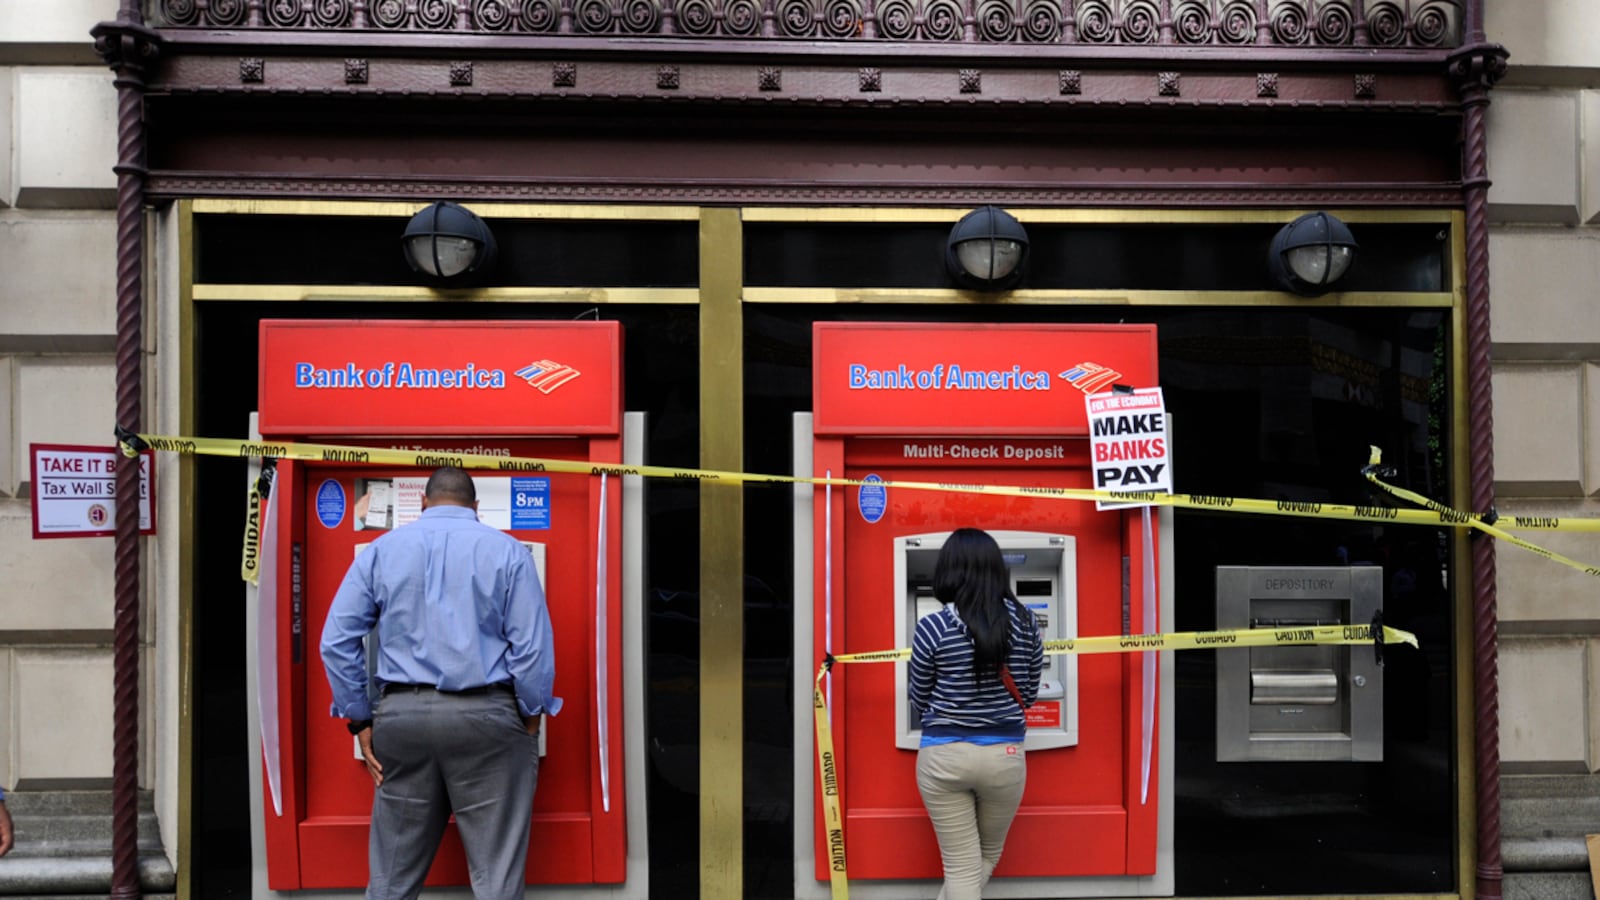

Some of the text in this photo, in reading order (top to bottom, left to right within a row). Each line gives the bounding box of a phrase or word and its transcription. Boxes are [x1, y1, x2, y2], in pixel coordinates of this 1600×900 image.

[295, 362, 505, 389] Bank of America
[849, 363, 1050, 390] Bank of America
[1091, 394, 1159, 412] FIX THE ECONOMY
[1093, 413, 1164, 437] MAKE
[412, 444, 511, 457] actions
[903, 445, 1064, 460] Multi-Check Deposit
[1095, 438, 1165, 462] BANKS
[41, 457, 83, 473] TAKE
[87, 459, 102, 473] IT
[1097, 464, 1165, 488] PAY
[42, 481, 67, 495] Tax
[71, 482, 103, 496] Wall
[1265, 579, 1335, 591] DEPOSITORY
